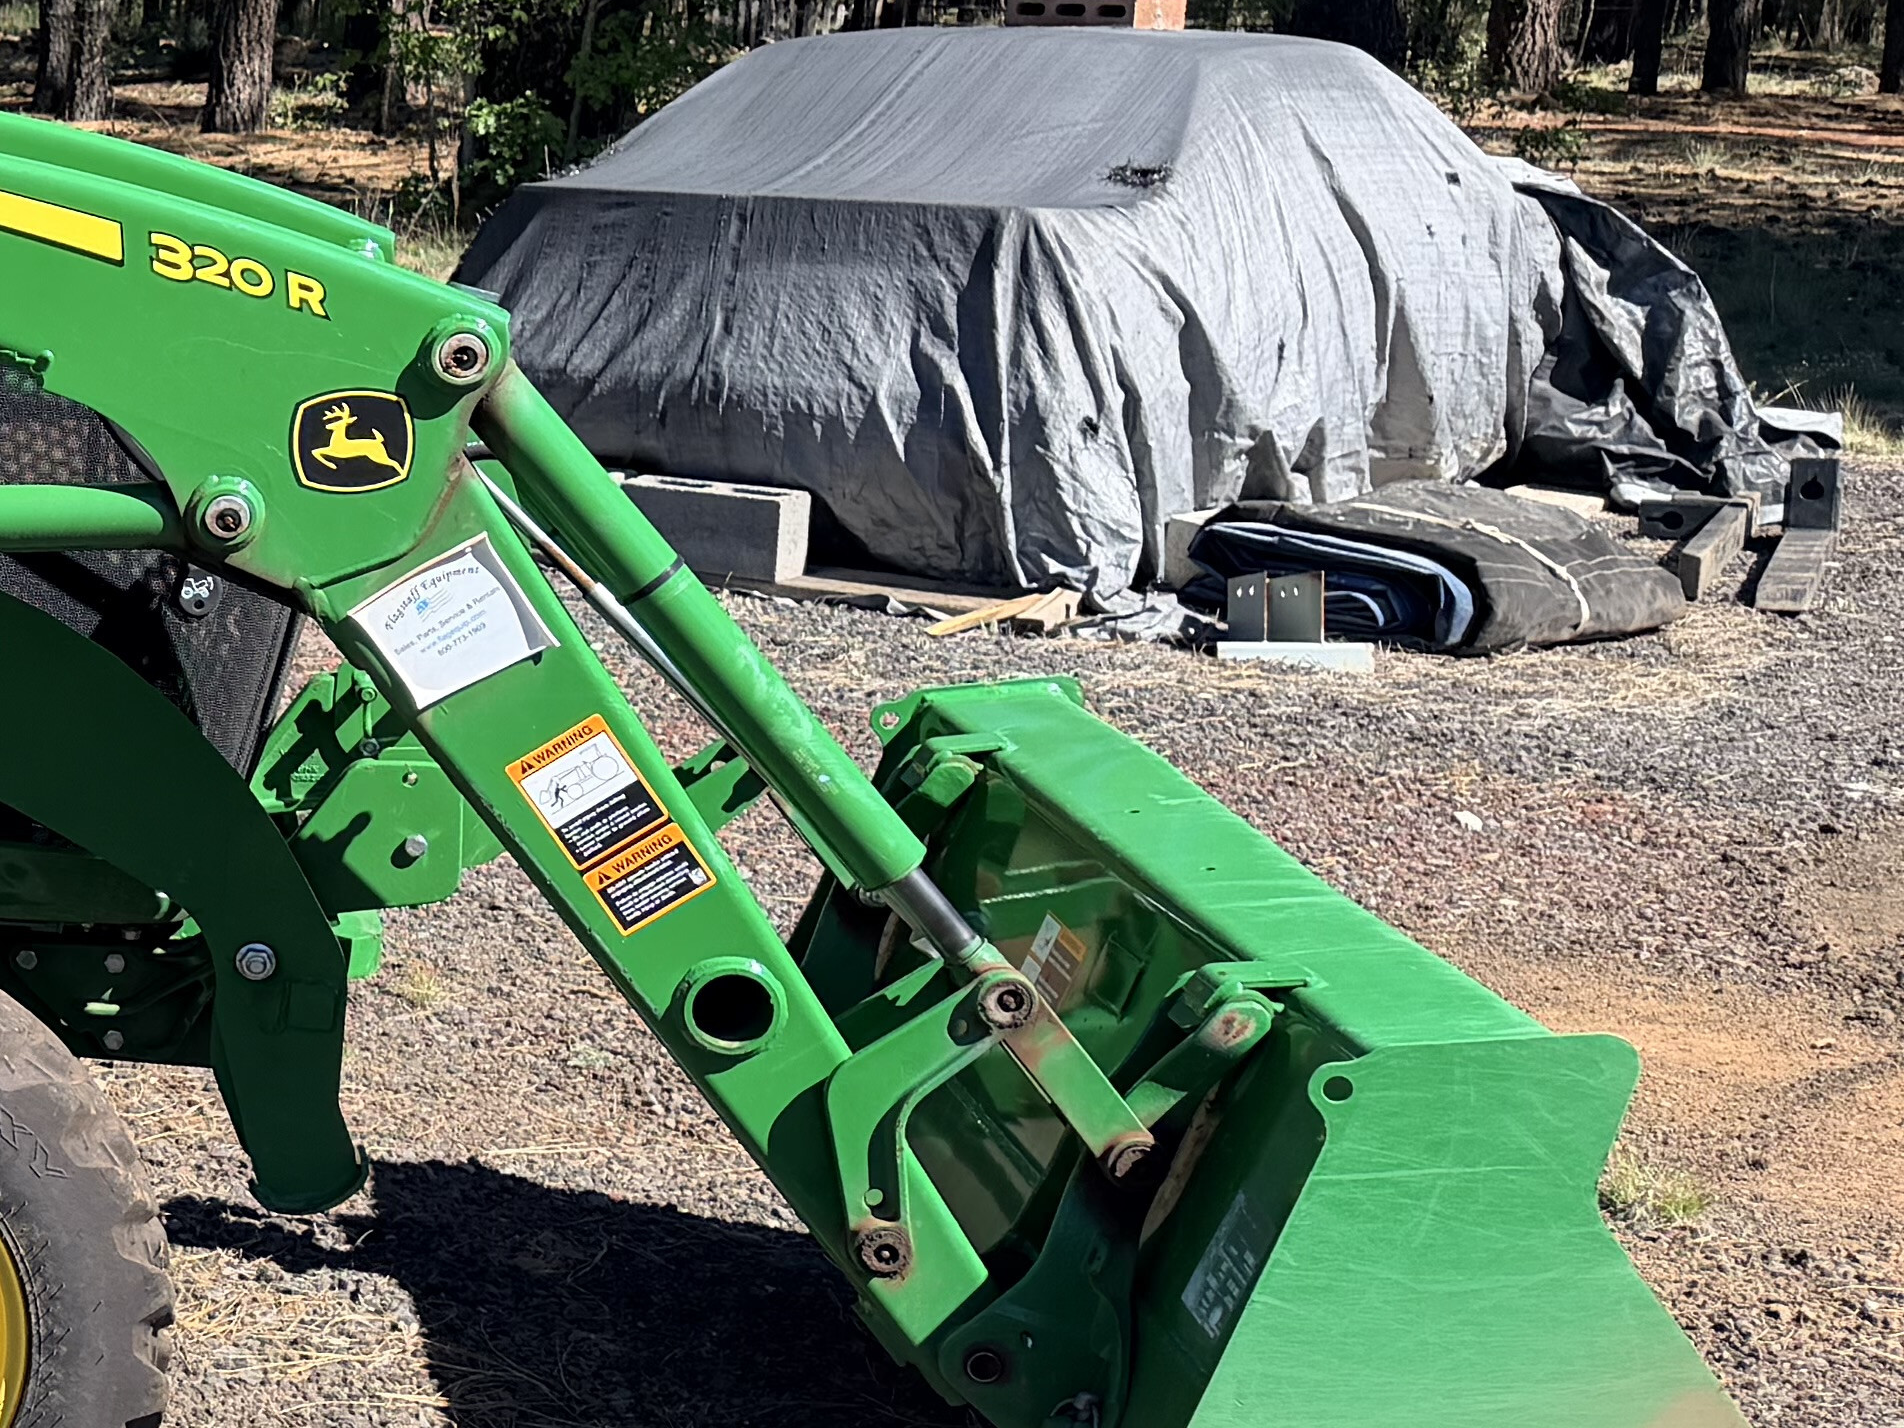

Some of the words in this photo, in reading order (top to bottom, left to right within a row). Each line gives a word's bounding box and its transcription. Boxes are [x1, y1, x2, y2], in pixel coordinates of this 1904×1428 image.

[149, 230, 275, 299] 320
[285, 268, 331, 320] R
[420, 566, 479, 590] Equipment
[533, 725, 593, 765] WARNING
[612, 834, 673, 874] WARNING
